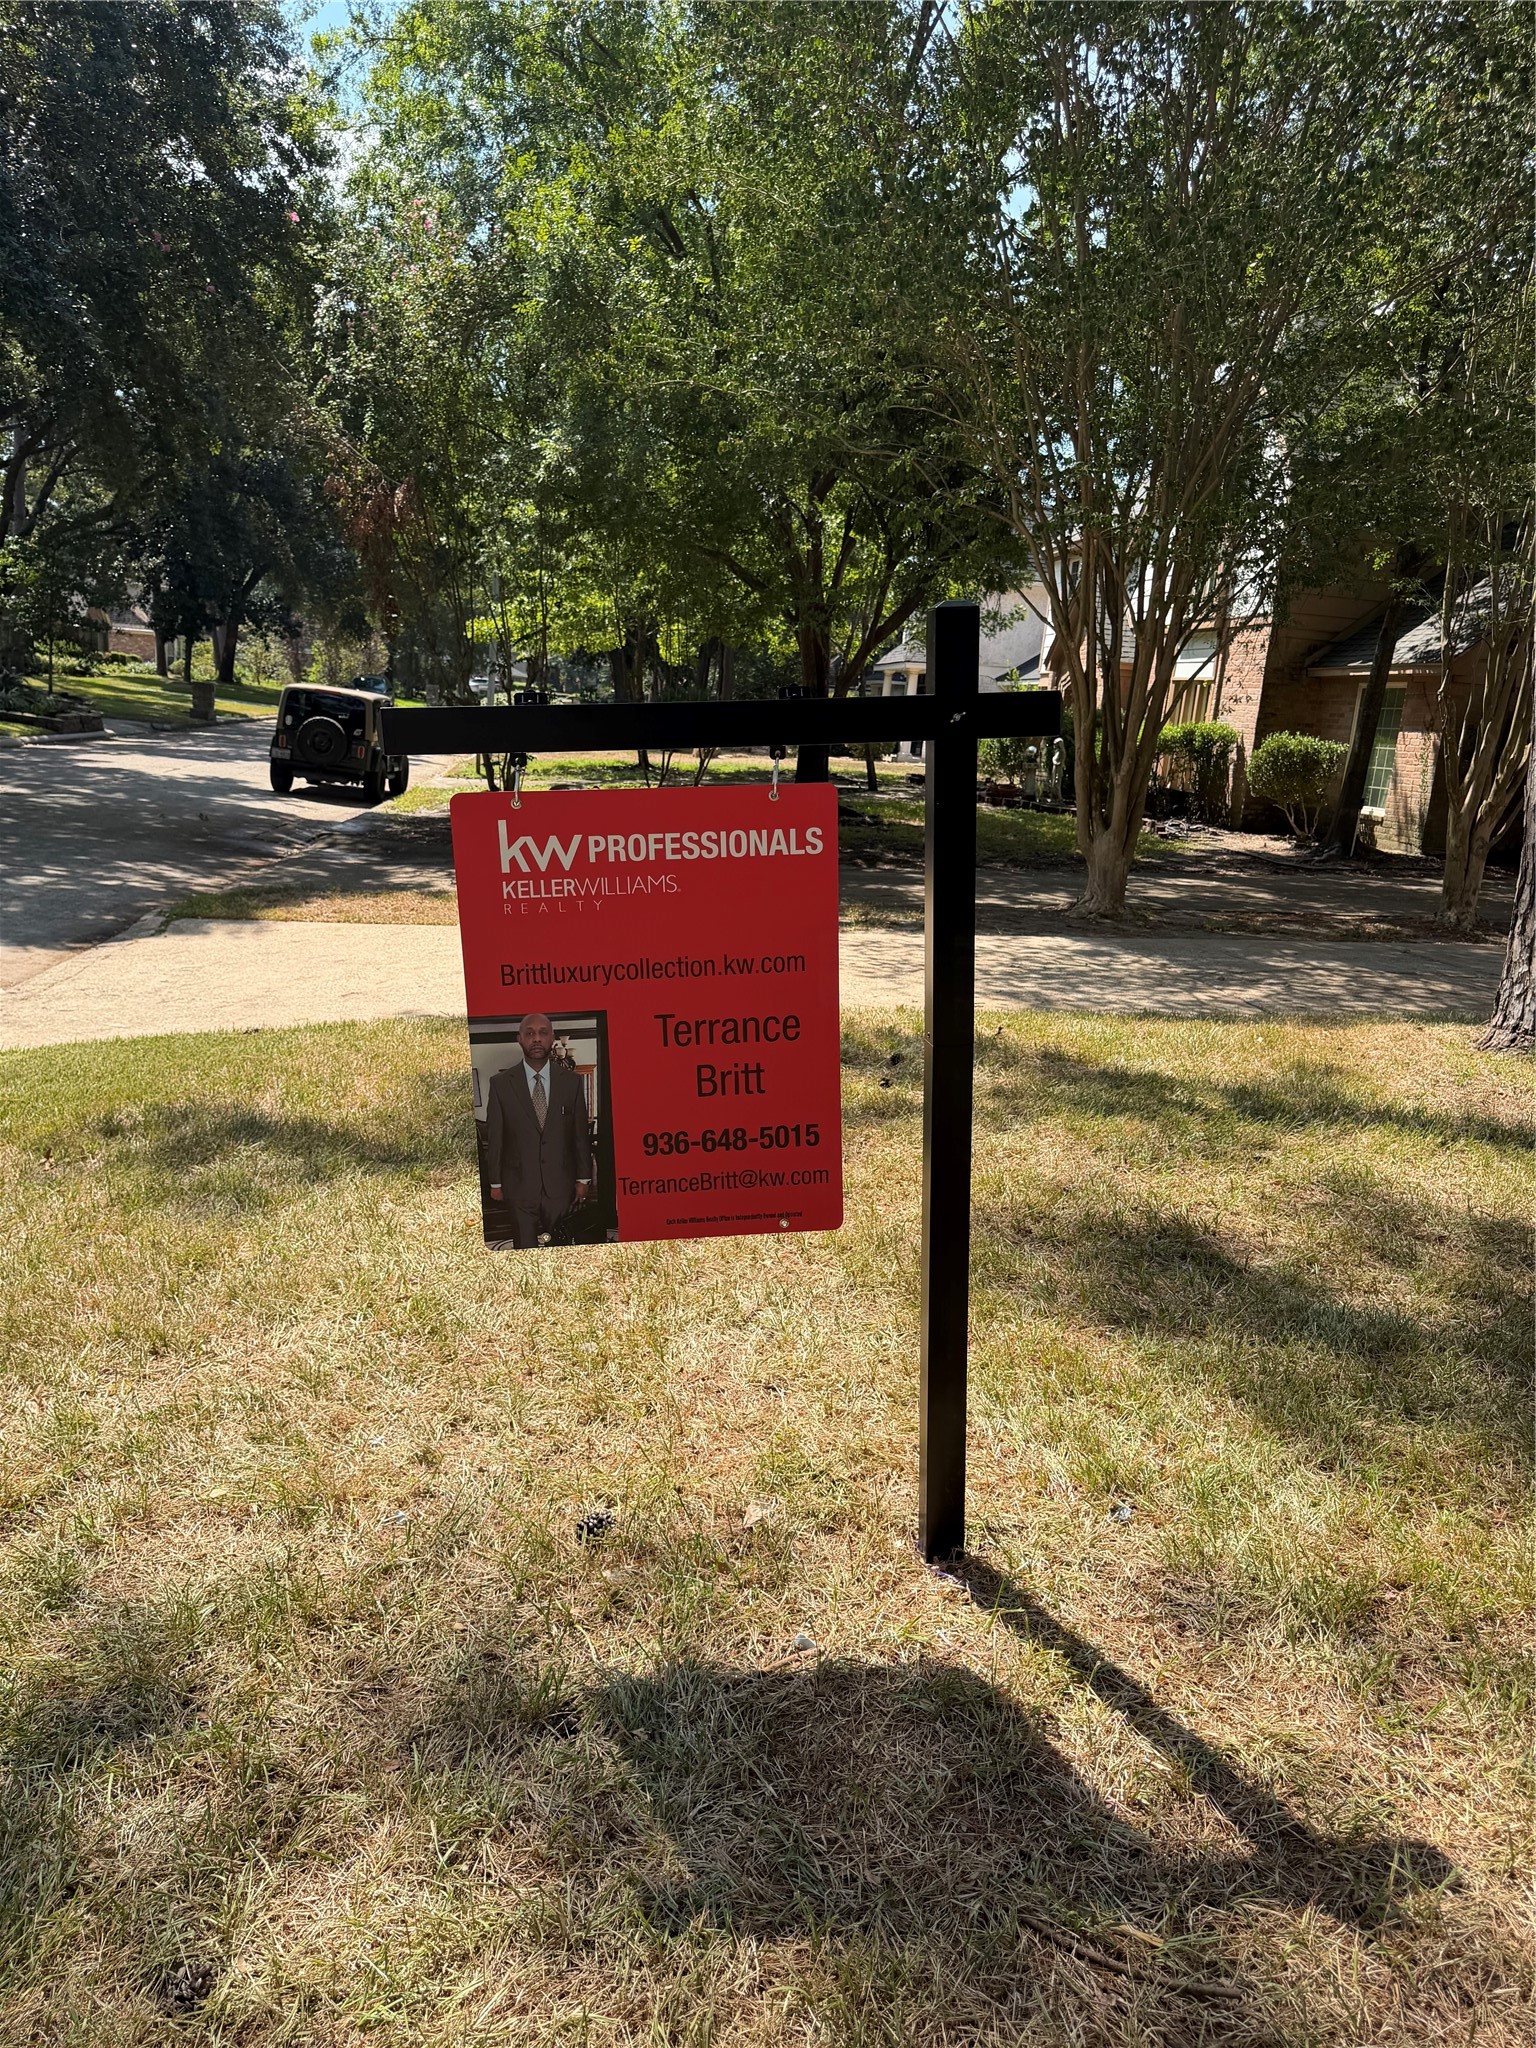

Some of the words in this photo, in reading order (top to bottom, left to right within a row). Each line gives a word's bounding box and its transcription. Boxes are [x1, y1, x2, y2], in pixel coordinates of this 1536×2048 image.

[498, 820, 582, 874] kw
[588, 827, 823, 863] PROFESSIONALS
[504, 899, 603, 915] REALTY
[501, 954, 806, 987] Brittluxurycollection.kw.com
[654, 1013, 801, 1048] Terrance
[696, 1062, 766, 1098] Britt
[643, 1123, 820, 1157] 936-648-5015
[618, 1167, 830, 1196] TerranceBritt@kw.com
